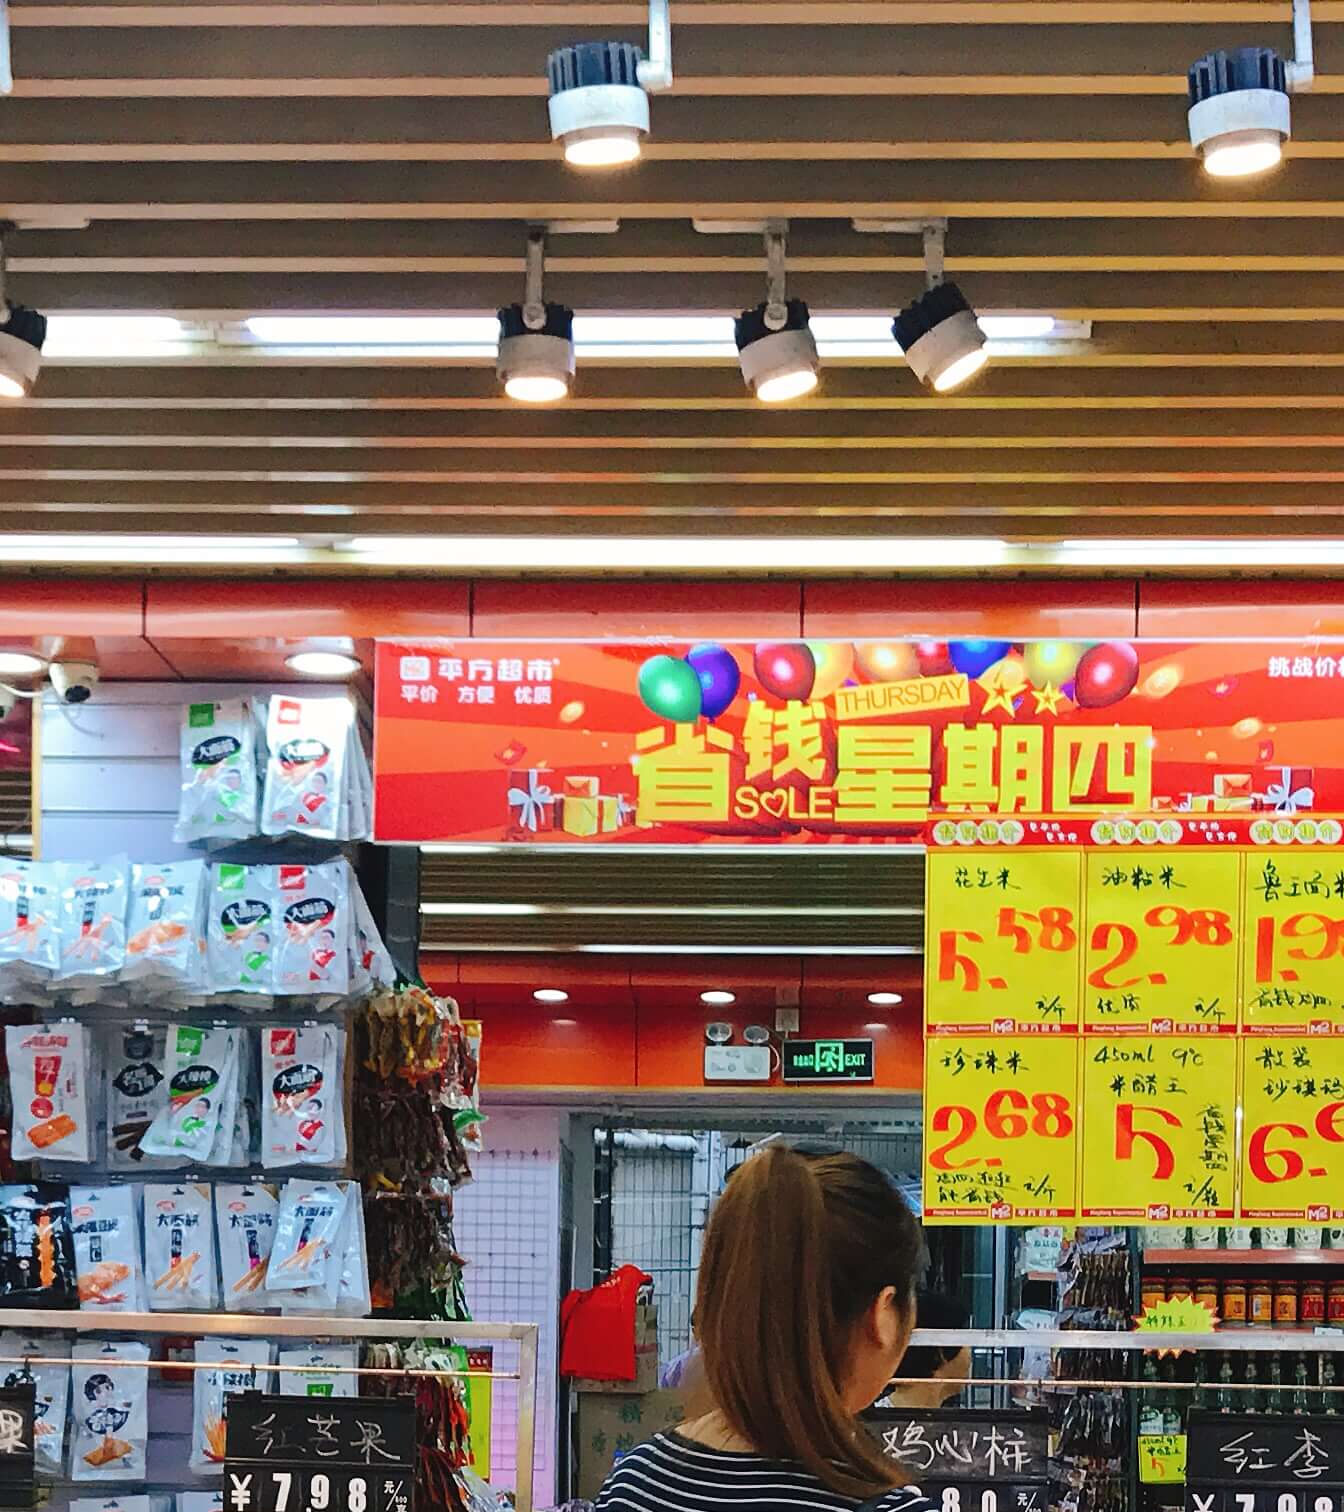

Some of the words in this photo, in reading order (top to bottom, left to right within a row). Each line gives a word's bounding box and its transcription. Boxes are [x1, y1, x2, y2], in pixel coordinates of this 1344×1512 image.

[438, 658, 556, 681] 平方超市
[401, 686, 438, 704] 平价
[458, 686, 495, 704] 方便
[514, 686, 552, 704] 优质
[839, 675, 967, 713] THURSDAY
[632, 700, 1153, 822] 省钱星期四
[955, 868, 1022, 890] 花生米
[1102, 867, 1187, 890] 油粘米
[939, 907, 1077, 992] 5.58
[1088, 904, 1233, 989] 2.98
[845, 1054, 865, 1067] EXIT
[940, 1046, 1030, 1076] 珍珠米
[1094, 1045, 1155, 1063] 450ml
[1110, 1073, 1187, 1096] 米醋王
[928, 1089, 1073, 1170] 2.68
[1115, 1103, 1183, 1180] 5
[253, 1413, 402, 1464] 红芒果
[882, 1420, 1033, 1475] 鸡心柿
[1220, 1427, 1330, 1477] 红李
